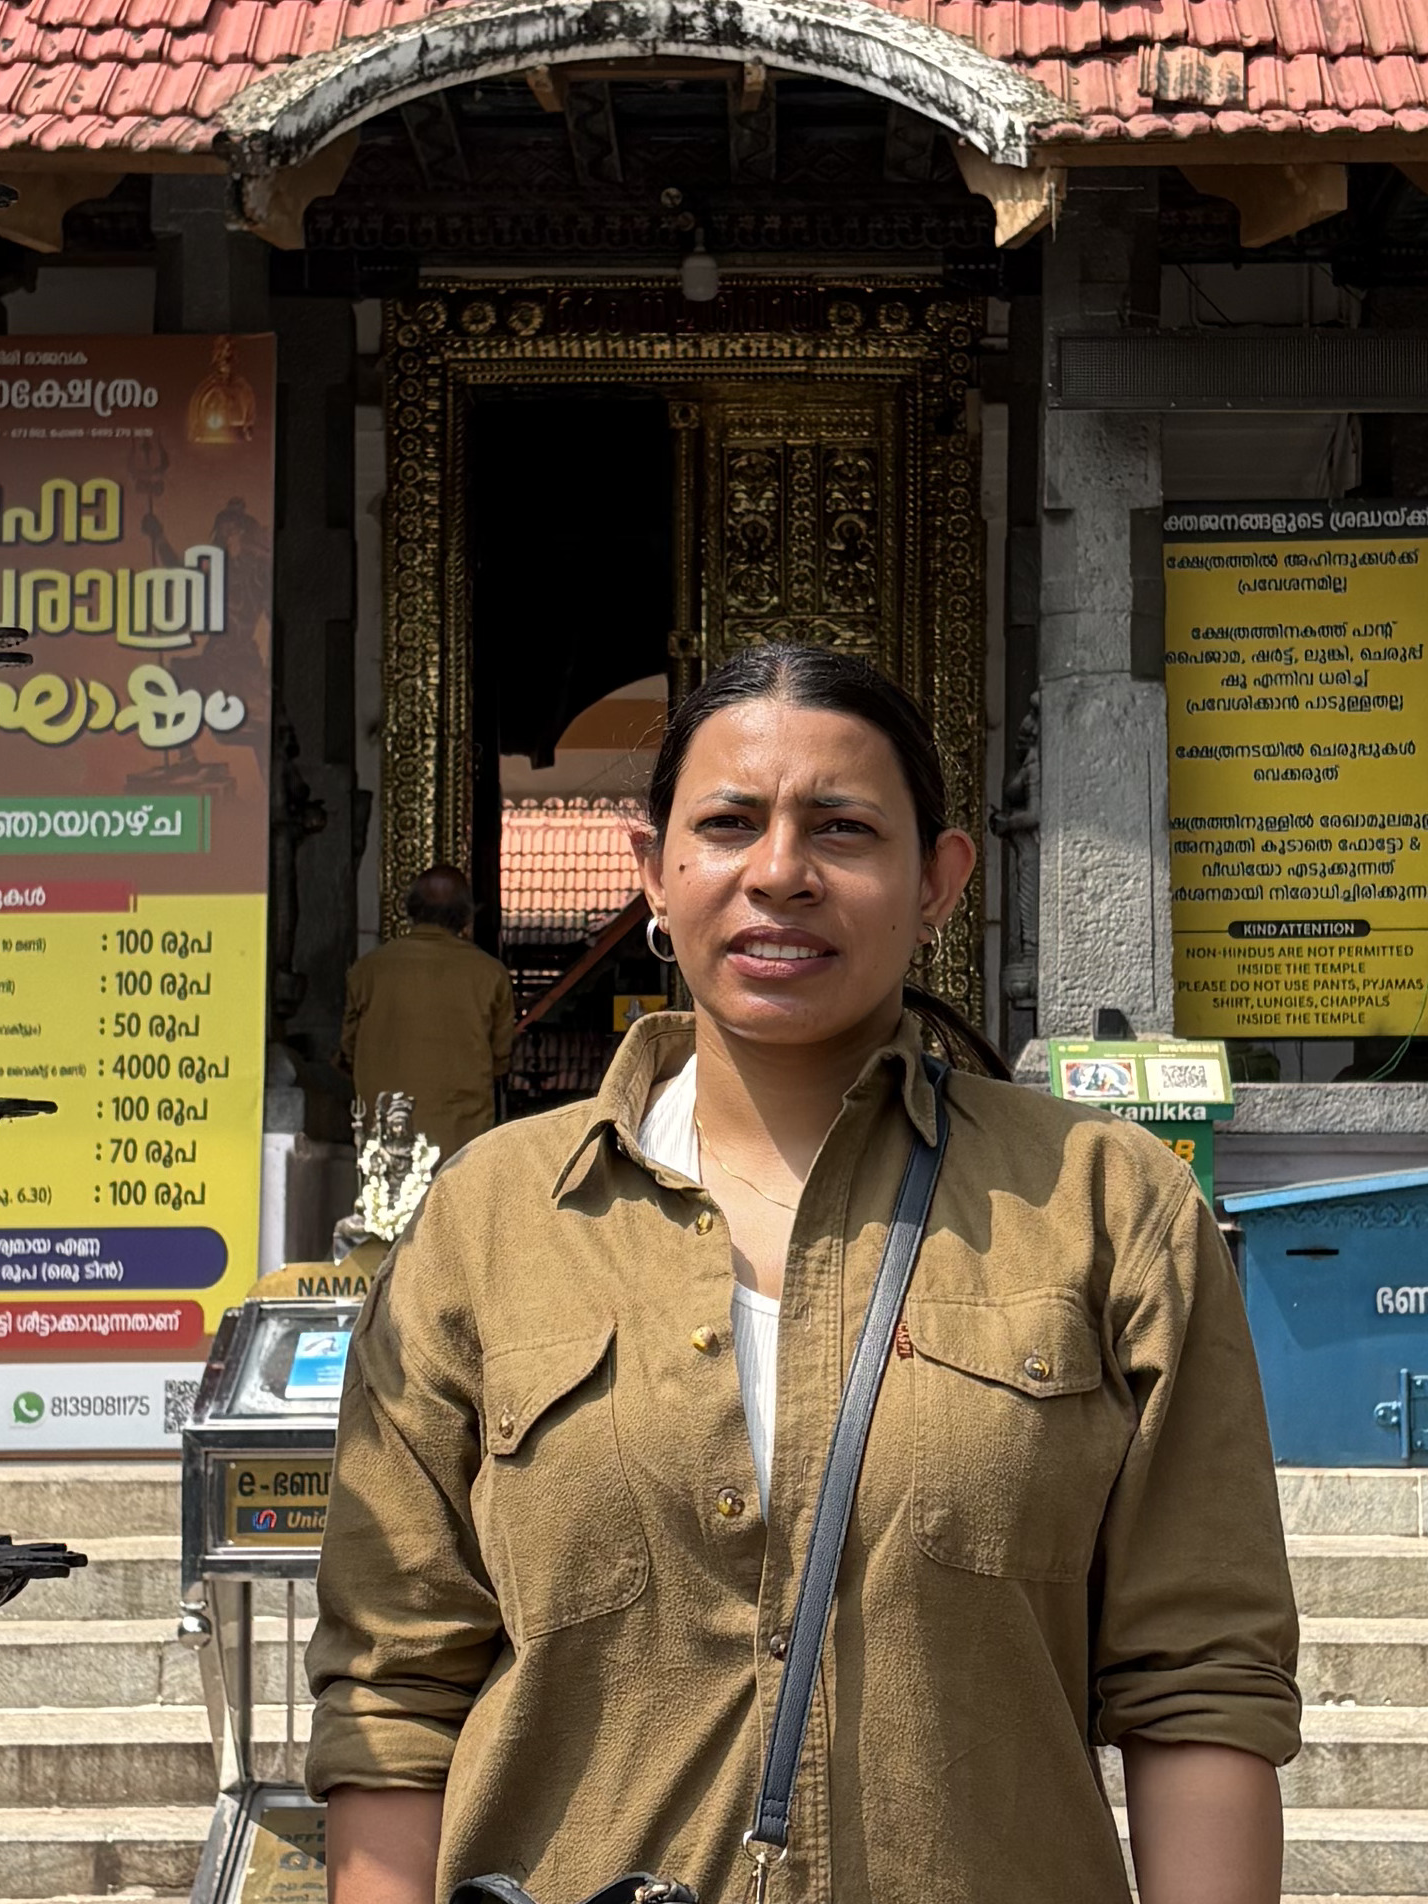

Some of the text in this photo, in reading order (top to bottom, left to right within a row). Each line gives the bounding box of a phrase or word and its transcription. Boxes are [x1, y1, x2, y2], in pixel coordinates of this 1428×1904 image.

[1162, 510, 1325, 535] ക്തജനങ്ങളുടെ
[1409, 836, 1422, 852] &
[1171, 883, 1264, 902] ർശനമായി
[1242, 922, 1357, 937] KIND ATTENTION
[114, 929, 155, 956] 100
[160, 930, 213, 960] രൂപ
[1185, 944, 1414, 959] NON-HINDUS ARE NOT PERMITTED
[1237, 962, 1366, 975] INSIDE THE TEMPLE
[113, 971, 154, 997] 100
[159, 972, 212, 1001] രൂപ
[1178, 980, 1228, 992] PLEASE
[1230, 980, 1251, 992] DO
[1253, 980, 1281, 992] NOT
[1283, 979, 1310, 991] USE
[1362, 978, 1425, 992] PYJAMAS
[1320, 995, 1391, 1008] CHAPPALS
[111, 1013, 142, 1039] 50
[148, 1014, 200, 1043] രൂപ
[1237, 1012, 1366, 1026] INSIDE THE TEMPLE
[111, 1055, 172, 1080] 4000
[177, 1055, 230, 1084] രൂപ
[111, 1096, 209, 1127] 100 രൂപ
[108, 1138, 197, 1169] 70 രൂപ
[17, 1186, 53, 1206] 6.30)
[108, 1180, 148, 1207] 100
[154, 1182, 207, 1212] രൂപ
[1, 1263, 38, 1284] രൂപ
[50, 1395, 151, 1418] 8139081175
